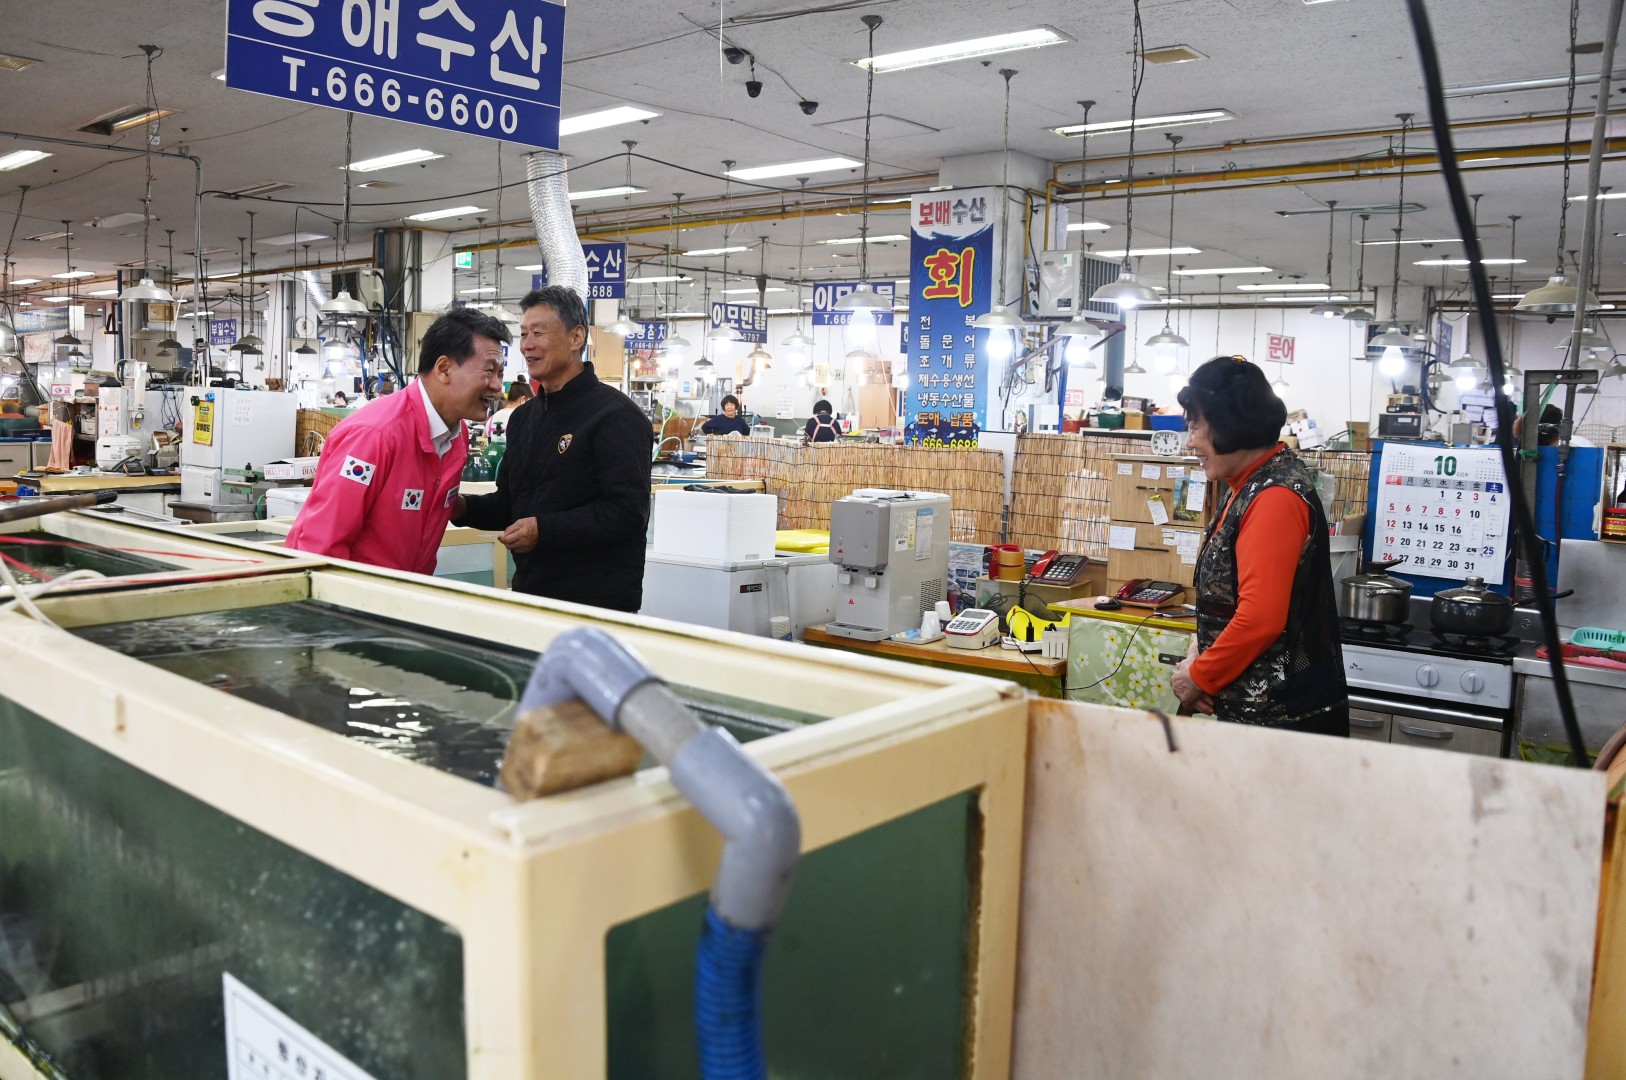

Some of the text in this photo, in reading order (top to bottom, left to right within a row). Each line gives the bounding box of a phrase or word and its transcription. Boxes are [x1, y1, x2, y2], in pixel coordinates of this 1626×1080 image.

[282, 55, 518, 134] T.666-6600
[919, 197, 986, 226] 보배수산
[586, 249, 622, 279] 수산
[923, 247, 975, 307] 회
[712, 304, 766, 330] 이모민물
[1269, 336, 1295, 362] 문어
[918, 373, 974, 388] 제수용생선
[918, 392, 974, 408] 냉동수산물
[1434, 456, 1457, 476] 10
[1456, 492, 1462, 500] 2
[1470, 510, 1480, 518] 10
[1435, 524, 1445, 532] 15
[1433, 541, 1443, 549] 22
[1450, 543, 1460, 551] 23
[1483, 546, 1494, 555] 25
[1431, 558, 1441, 566] 29
[1448, 560, 1458, 568] 30
[1464, 562, 1474, 570] 31
